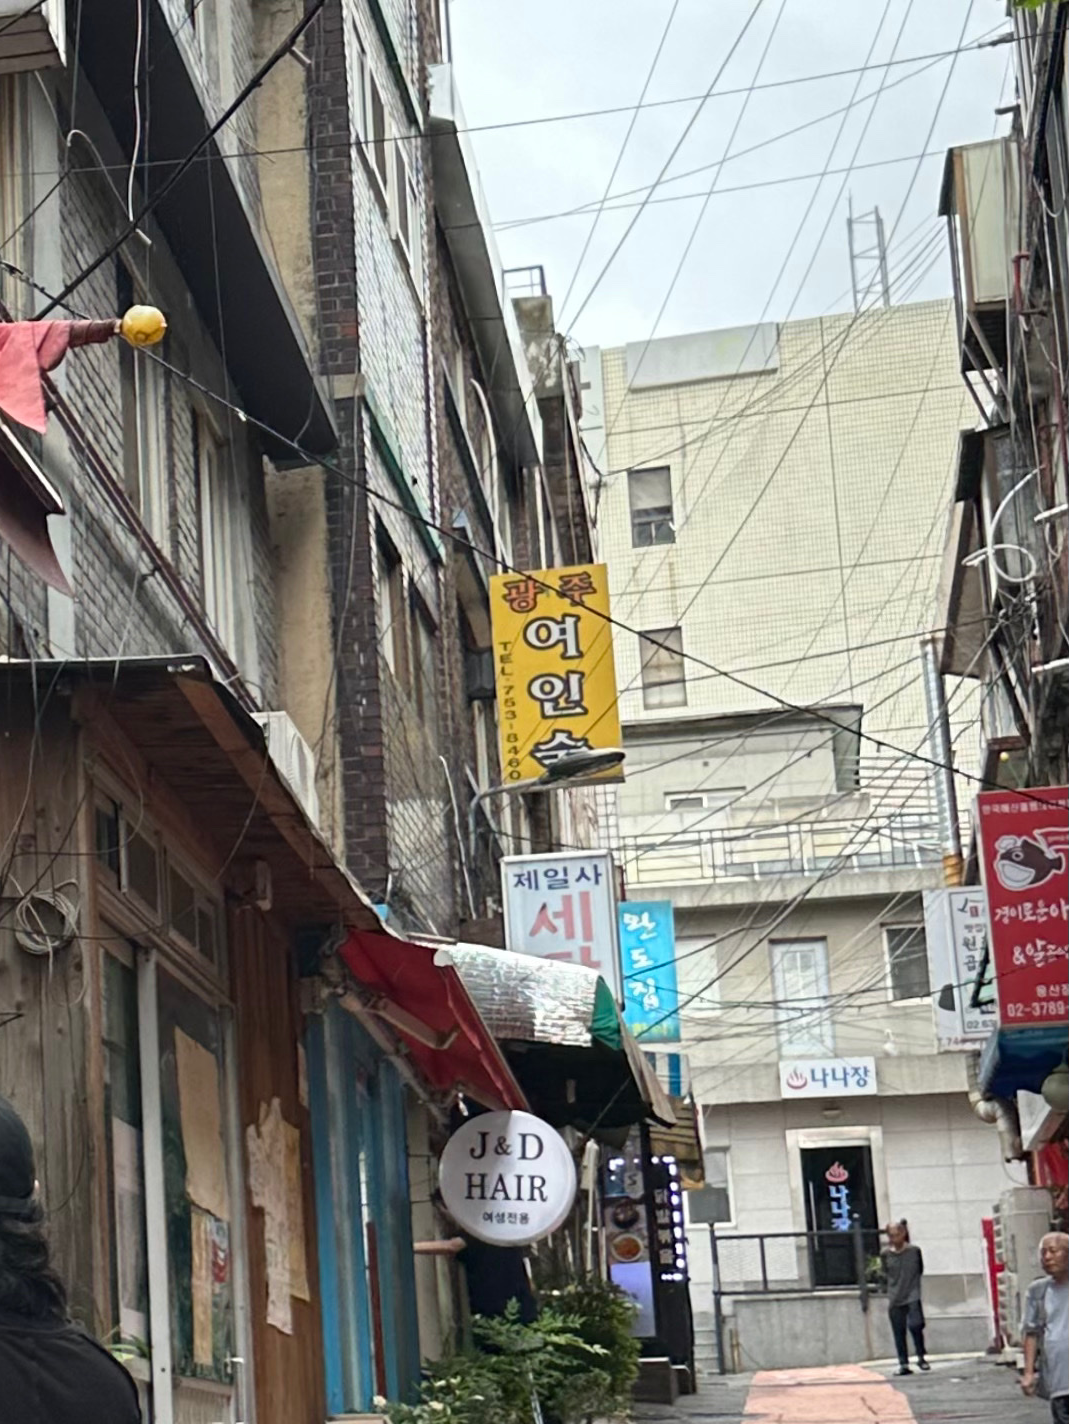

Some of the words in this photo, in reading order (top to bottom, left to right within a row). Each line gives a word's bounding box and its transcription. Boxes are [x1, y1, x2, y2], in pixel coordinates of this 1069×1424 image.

[502, 571, 597, 613] 광주
[513, 864, 602, 892] 제일사
[811, 1066, 871, 1088] 나나장
[464, 1172, 548, 1202] HAIR
[482, 1210, 530, 1225] 여성전용
[829, 1185, 852, 1231] 나나장
